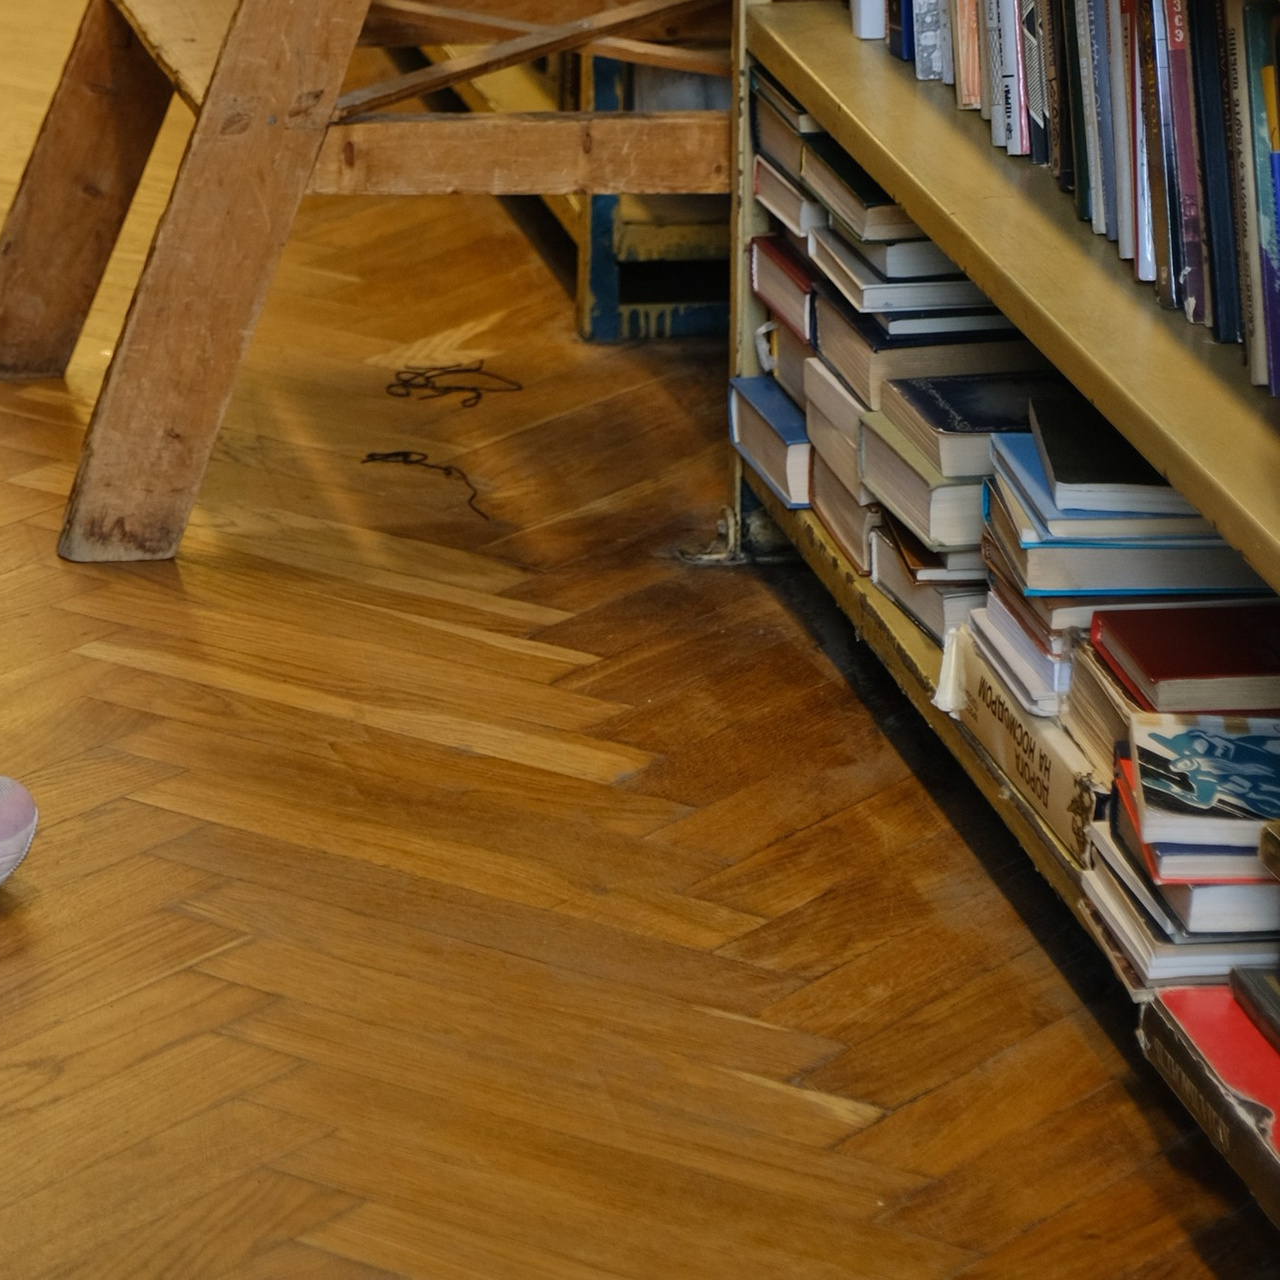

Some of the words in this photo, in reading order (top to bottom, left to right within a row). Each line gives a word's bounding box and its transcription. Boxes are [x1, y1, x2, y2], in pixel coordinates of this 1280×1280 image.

[1092, 93, 1102, 122] ПО
[1014, 748, 1049, 809] ДОРОГА
[1038, 746, 1052, 779] НА
